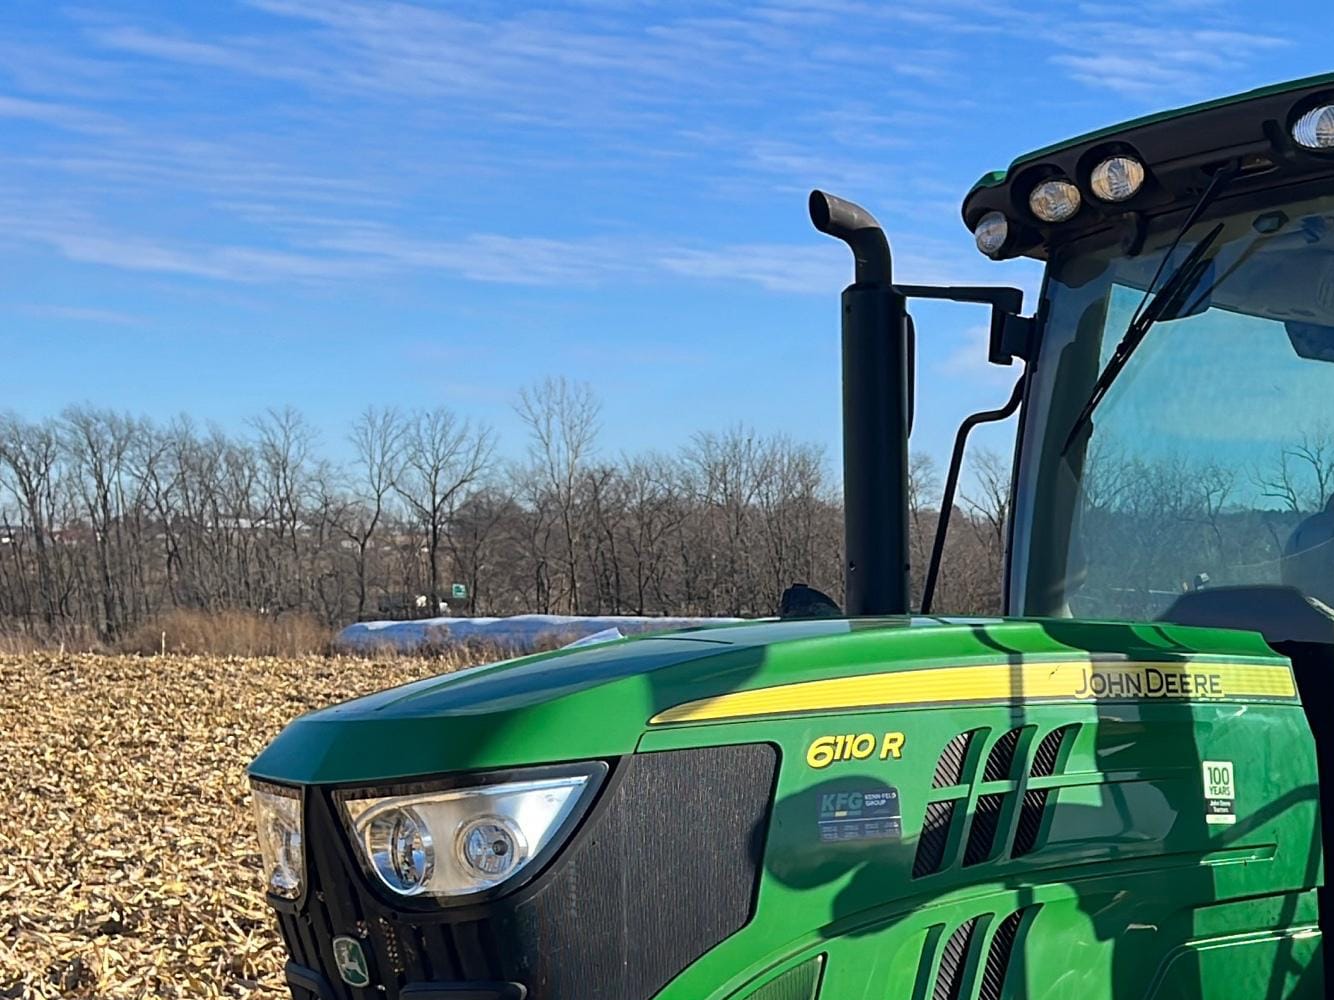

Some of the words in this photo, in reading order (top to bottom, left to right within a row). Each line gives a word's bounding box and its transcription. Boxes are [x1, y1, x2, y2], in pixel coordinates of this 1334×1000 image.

[1075, 668, 1143, 695] JOHN
[1145, 668, 1223, 695] DEERE
[806, 733, 877, 769] 6110
[879, 732, 905, 760] R
[1207, 766, 1230, 786] 100
[1209, 785, 1231, 796] YEARS
[820, 791, 863, 812] KFG
